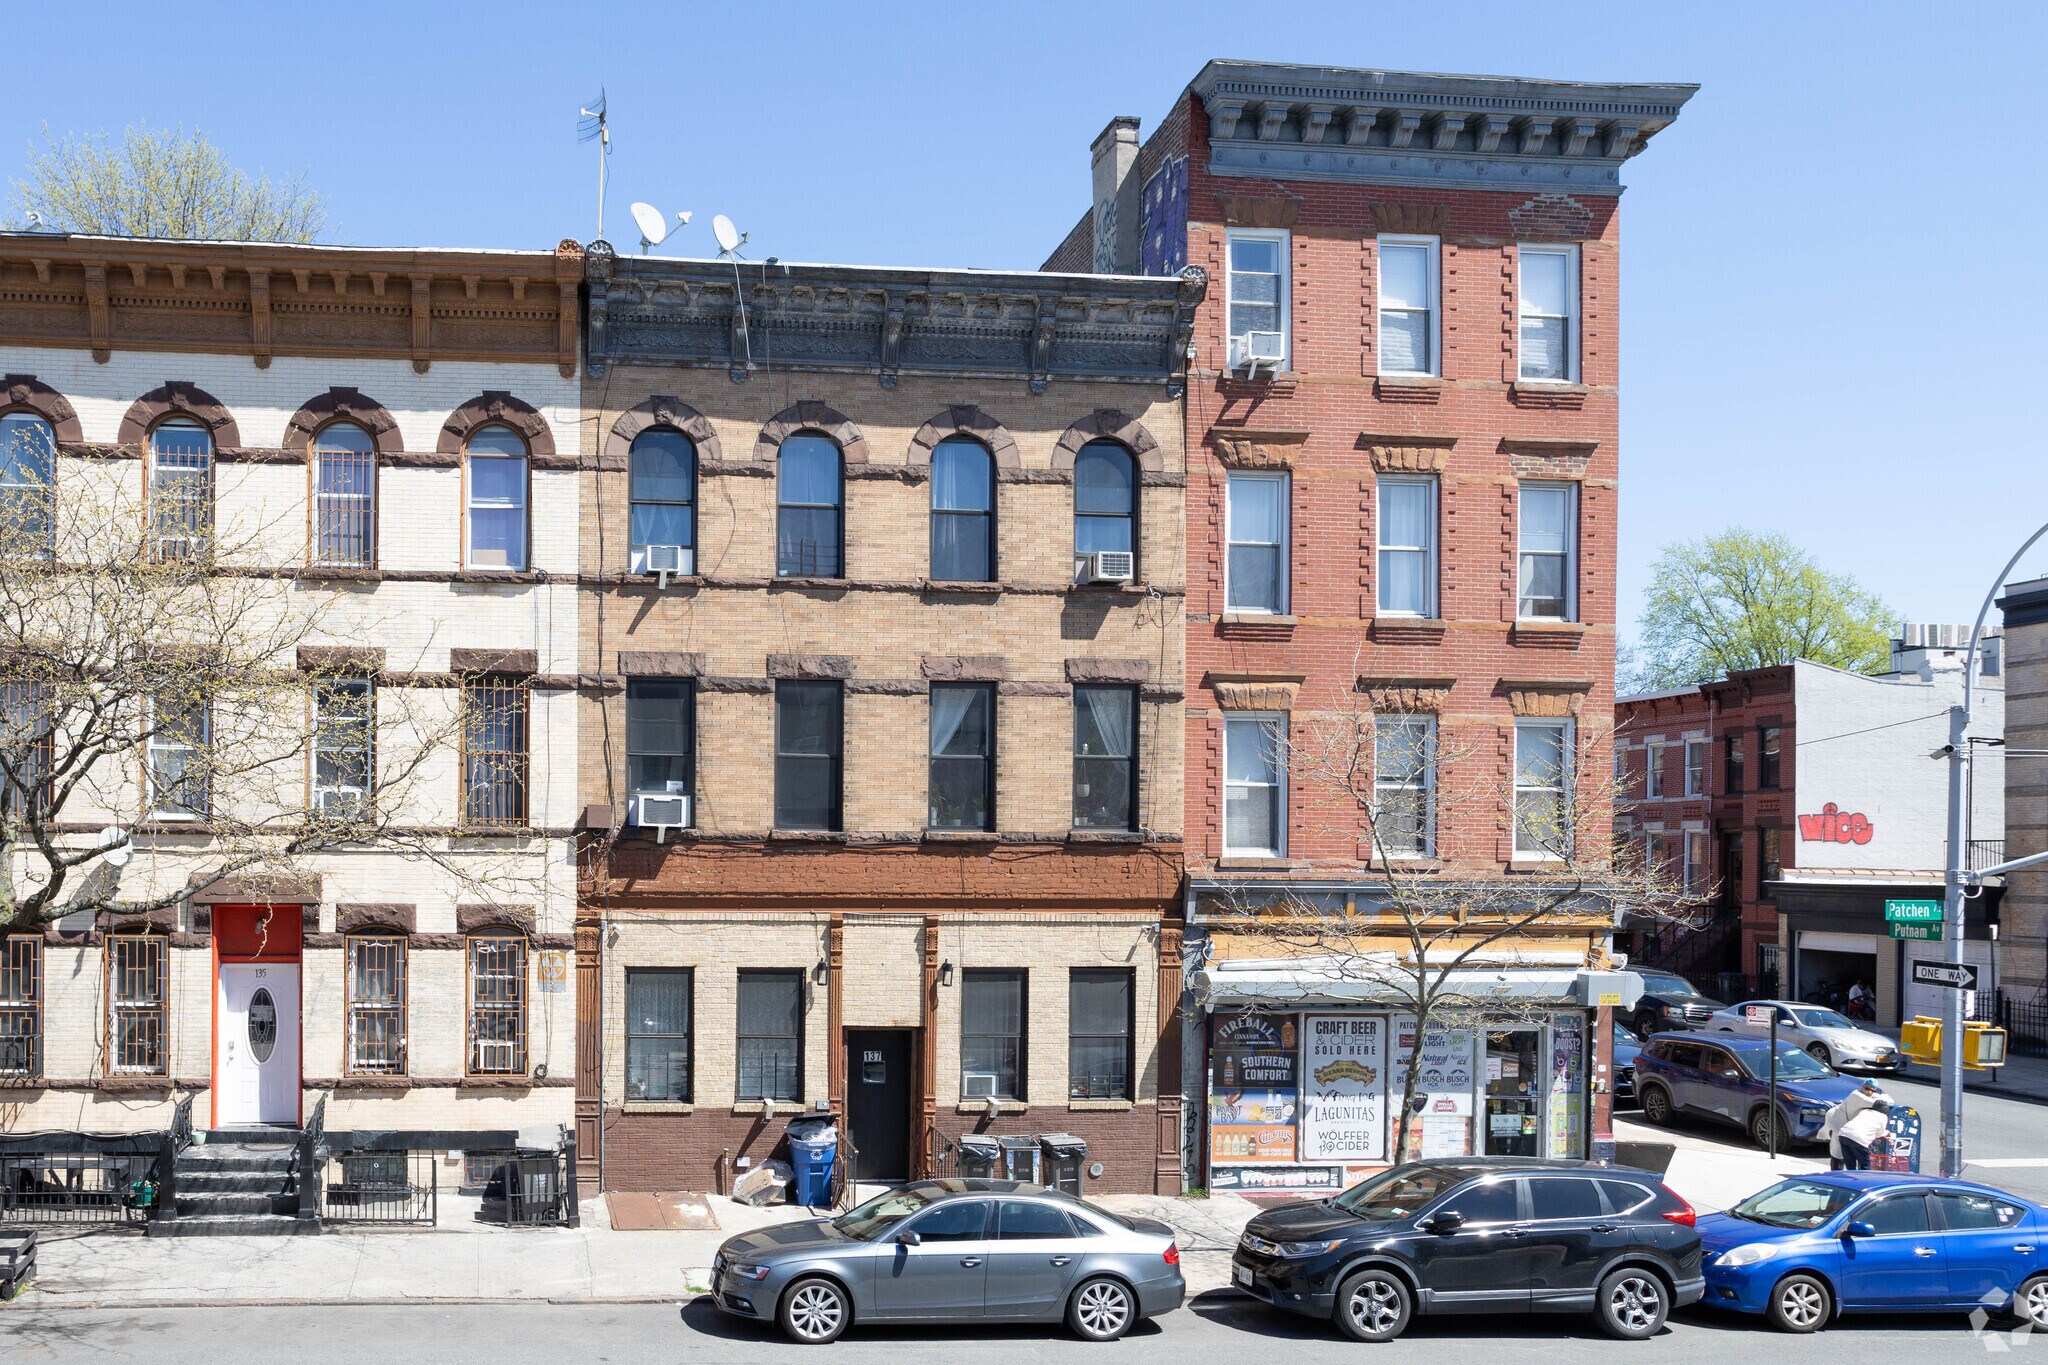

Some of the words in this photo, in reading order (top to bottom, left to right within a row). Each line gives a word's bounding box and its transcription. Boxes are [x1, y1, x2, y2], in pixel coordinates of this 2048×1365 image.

[1889, 903, 1930, 917] Patchen
[1894, 923, 1928, 938] Putnam
[1931, 924, 1940, 932] Av
[255, 968, 267, 978] 135
[1921, 967, 1940, 979] ONE
[1947, 970, 1968, 982] WAY
[1219, 1017, 1274, 1039] FIREBALL
[1316, 1021, 1348, 1034] CRAFT
[1351, 1021, 1377, 1034] BEER
[1316, 1035, 1325, 1045] &
[1330, 1035, 1376, 1045] CIDER
[1555, 1037, 1581, 1051] BOOST?
[865, 1051, 881, 1061] 137
[1315, 1046, 1342, 1055] SOLD
[1349, 1046, 1376, 1055] HERE
[1241, 1056, 1292, 1069] SOUTHERN
[1422, 1054, 1449, 1062] Natural
[1244, 1069, 1288, 1081] COMFORT
[1323, 1068, 1344, 1077] SIERRA
[1345, 1067, 1368, 1077] NEVADA
[1216, 1105, 1243, 1117] PARROT
[1315, 1106, 1375, 1122] LAGUNITAS
[1220, 1112, 1237, 1124] BAY
[1318, 1129, 1370, 1140] WÖLFFER
[1336, 1141, 1370, 1151] CIDER
